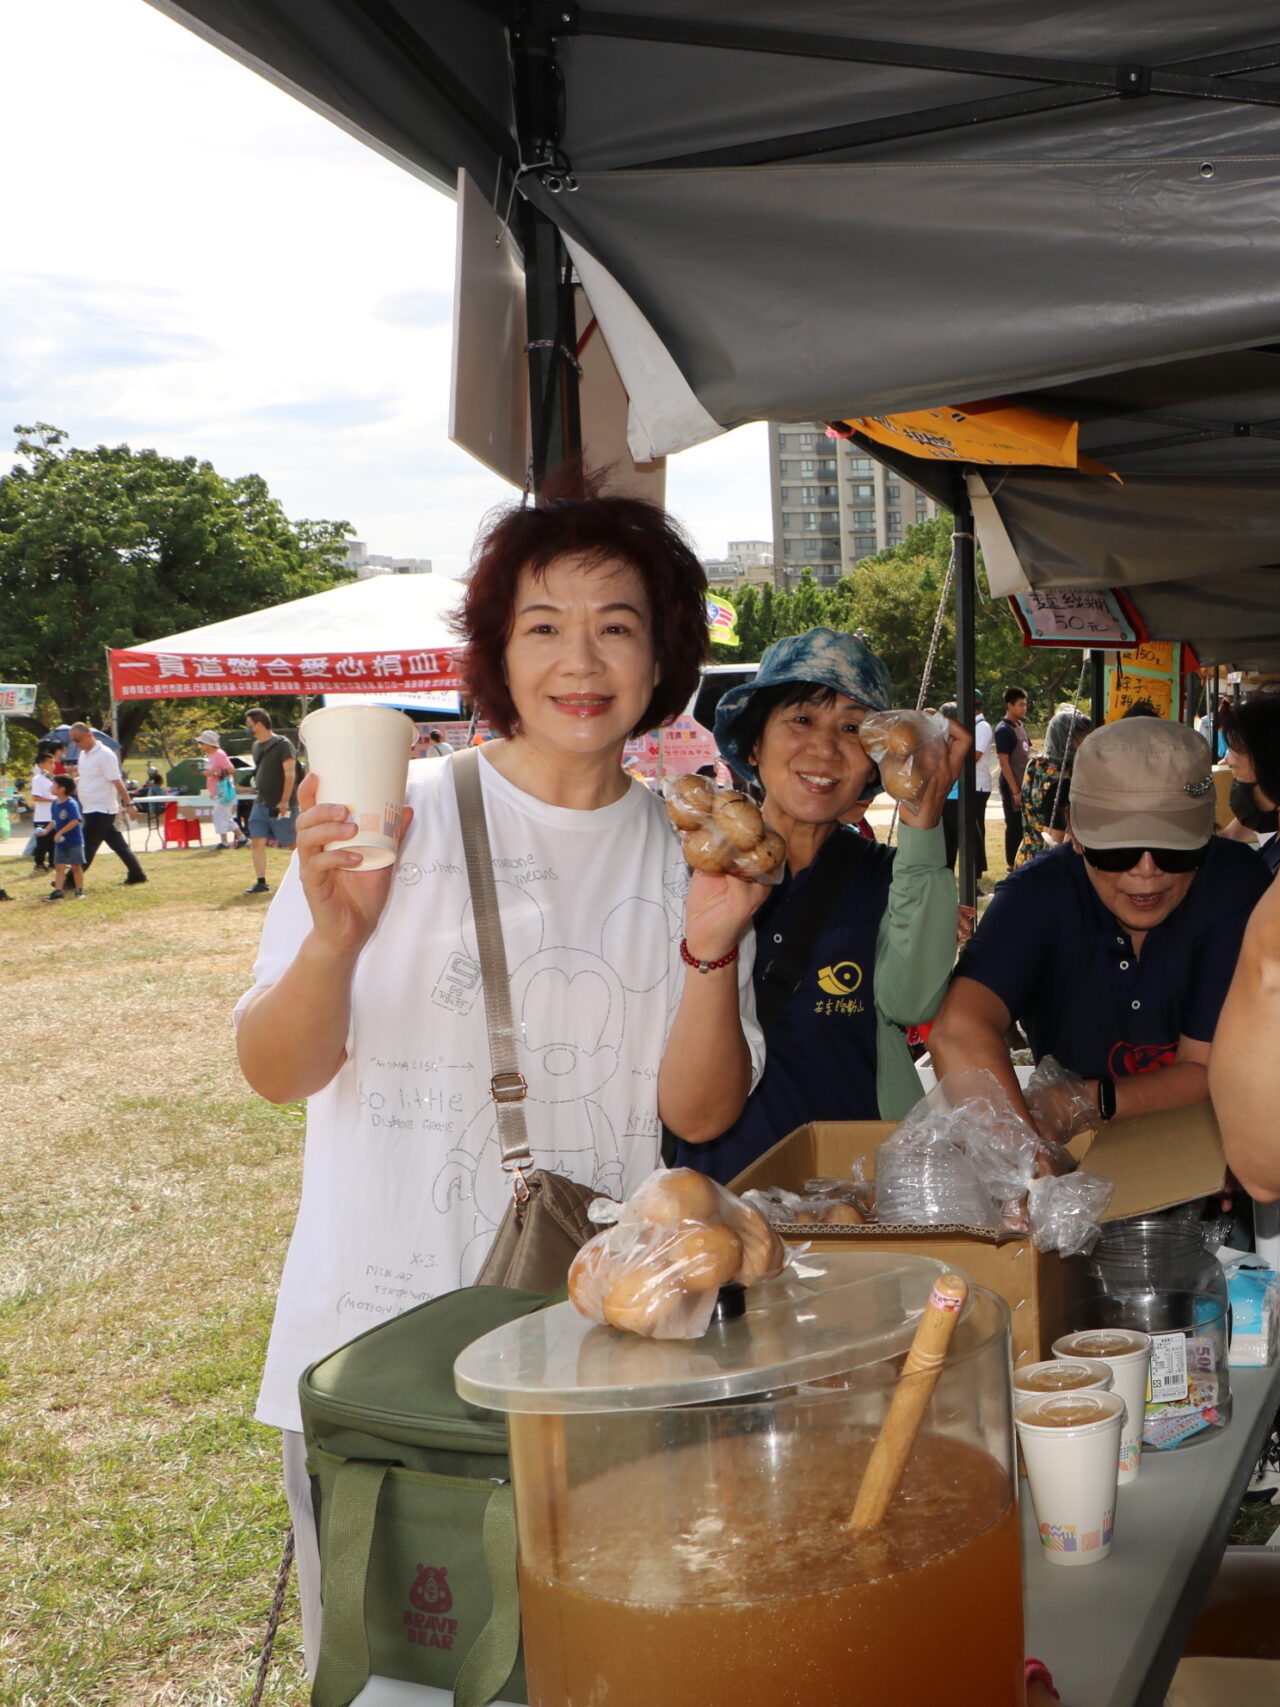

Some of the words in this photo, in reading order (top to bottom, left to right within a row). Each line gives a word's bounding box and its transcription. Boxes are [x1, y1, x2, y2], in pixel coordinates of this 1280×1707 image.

[1055, 614, 1109, 632] 50元
[403, 1611, 459, 1636] BRAVE
[407, 1628, 454, 1652] BEAR
